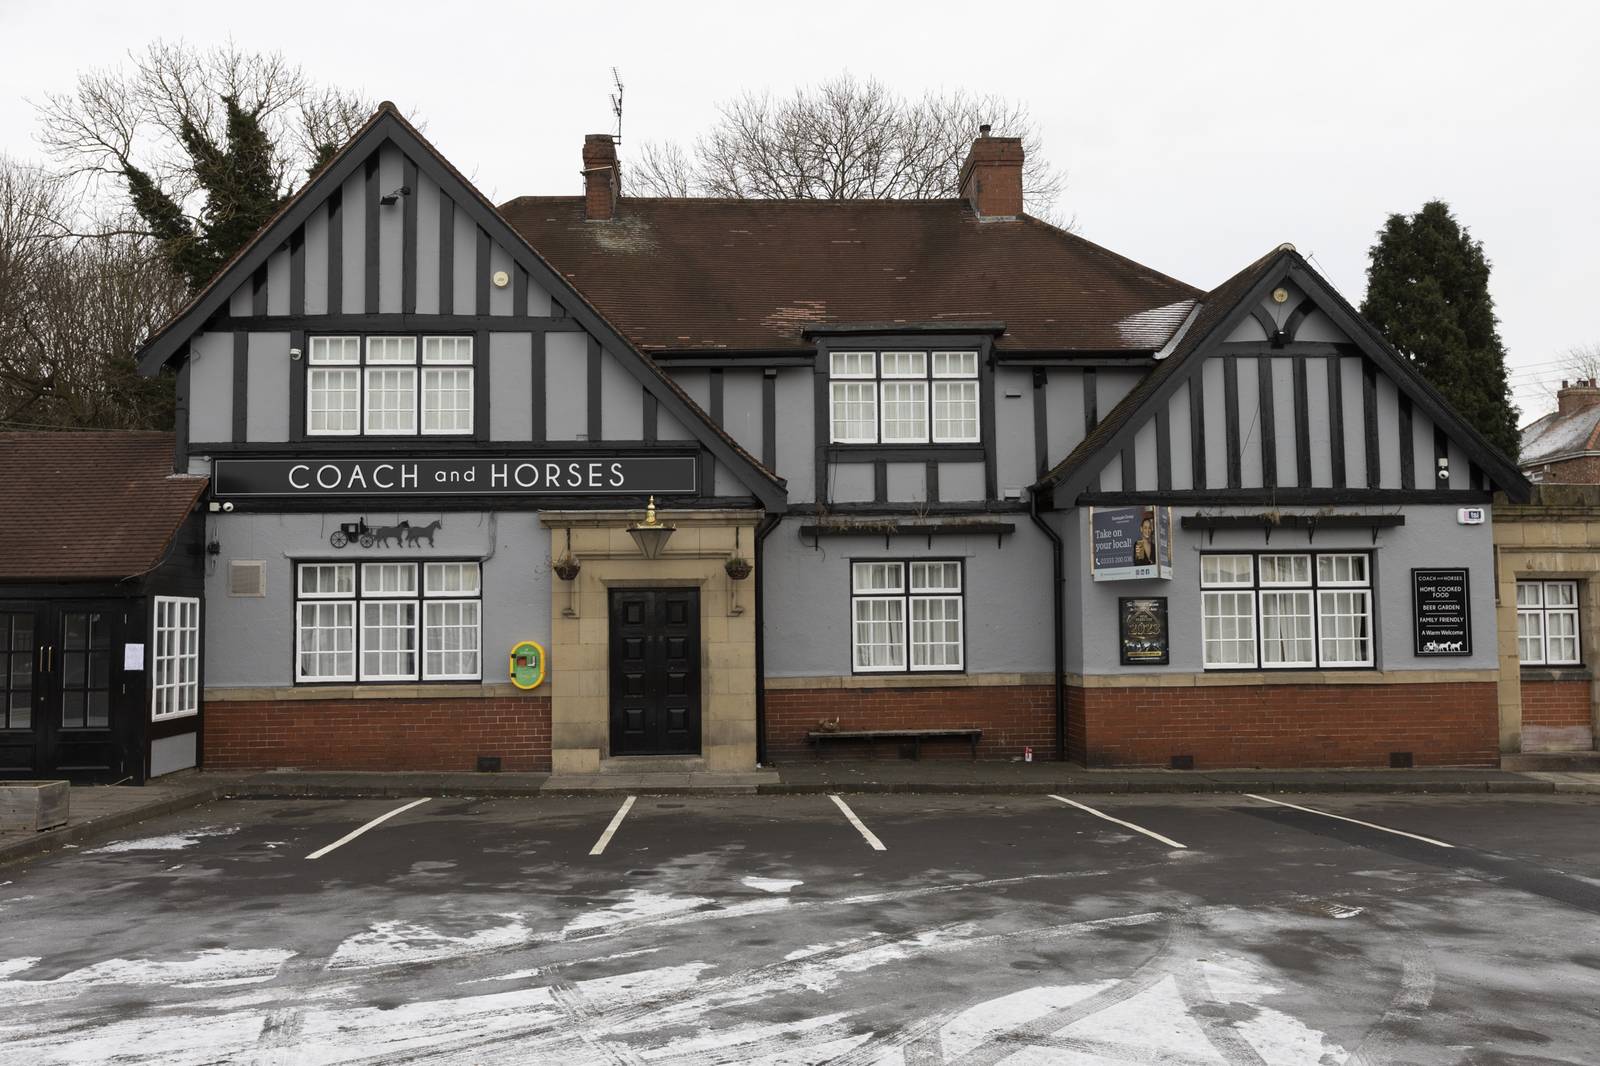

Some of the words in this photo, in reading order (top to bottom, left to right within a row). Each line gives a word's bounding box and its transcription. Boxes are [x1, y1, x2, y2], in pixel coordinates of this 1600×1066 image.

[288, 464, 418, 489] COACH
[434, 466, 476, 482] and
[491, 463, 625, 487] HORSES
[1095, 529, 1112, 539] Take
[1113, 529, 1122, 537] on
[1095, 541, 1112, 552] your
[1112, 538, 1132, 549] local!
